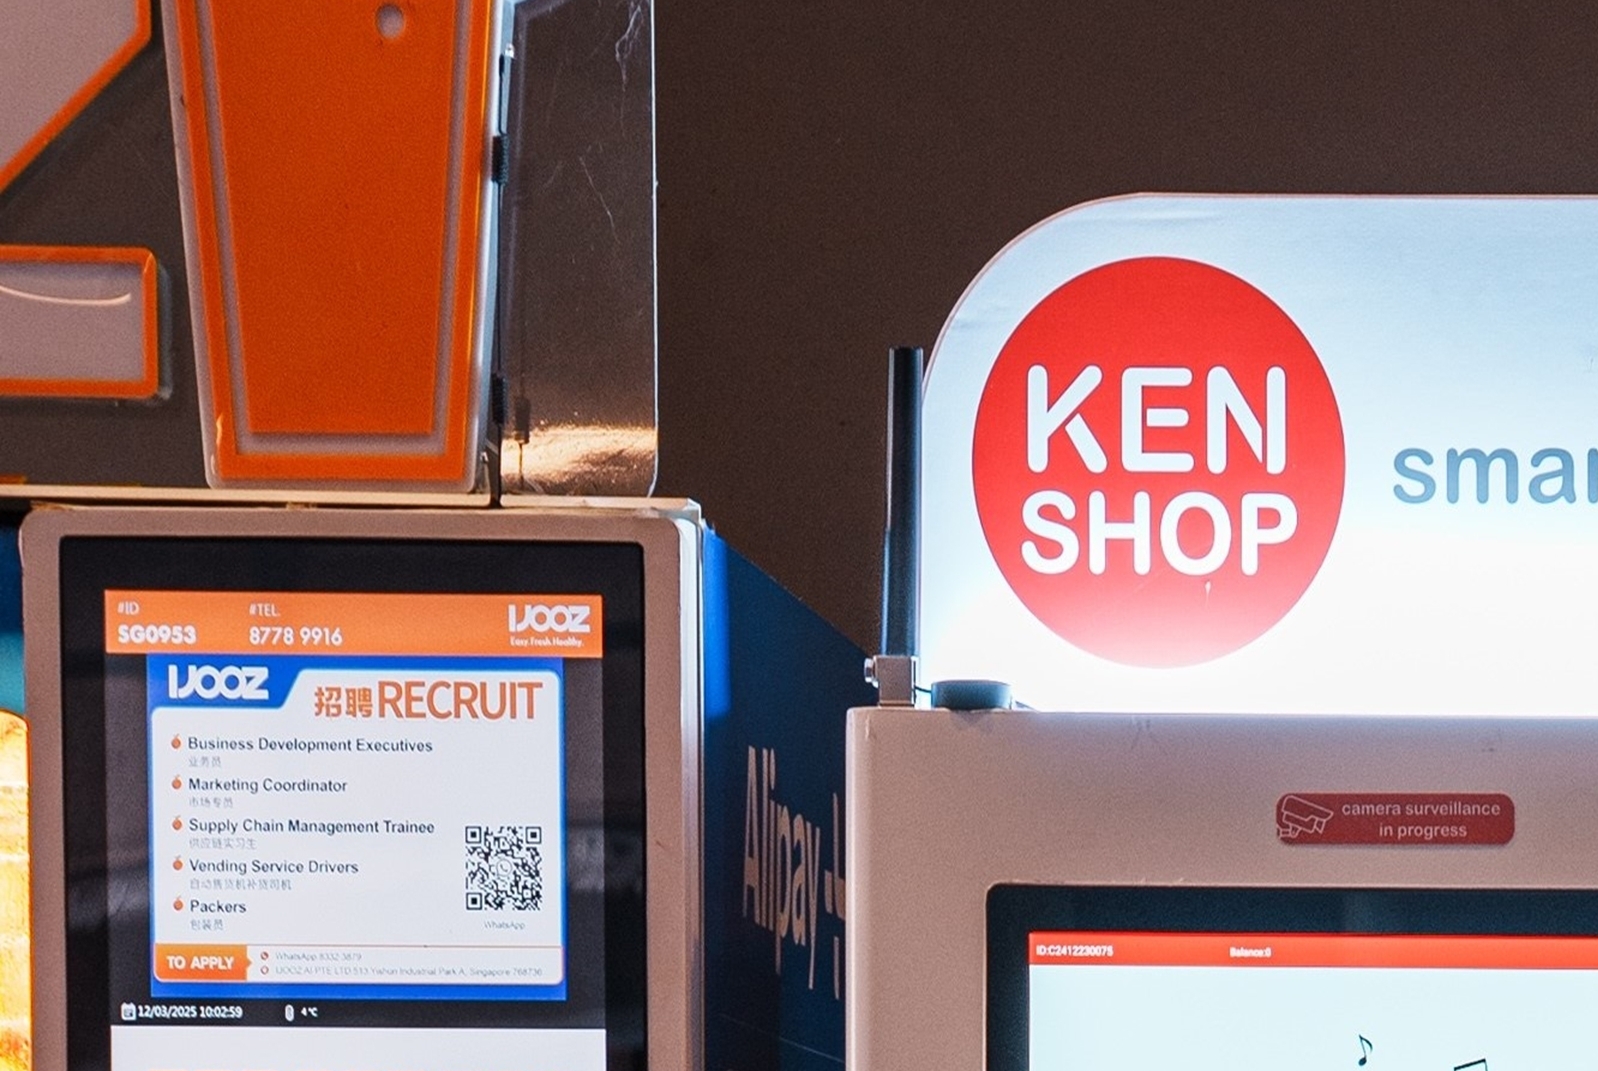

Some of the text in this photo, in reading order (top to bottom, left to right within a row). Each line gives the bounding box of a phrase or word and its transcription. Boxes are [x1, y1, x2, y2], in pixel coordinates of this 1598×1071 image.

[1025, 366, 1288, 477] KEN
[1019, 488, 1298, 576] SHOP
[118, 601, 140, 615] #ID
[117, 624, 197, 644] SG0953
[249, 626, 343, 646] 8778 9916
[314, 686, 373, 718] 招聘
[378, 680, 543, 720] RECRUIT
[188, 736, 434, 754] Business Development Executives
[188, 778, 348, 794] Marketing Coordinator
[1341, 801, 1501, 816] camera surveillance
[188, 818, 435, 836] Supply Chain Management Trainee
[1379, 822, 1468, 840] in progress
[189, 859, 359, 875] Vending Service Drivers
[190, 900, 247, 914] Packers
[166, 955, 235, 970] TO APPLY
[138, 1005, 243, 1019] 12/03/2025 10:02:59
